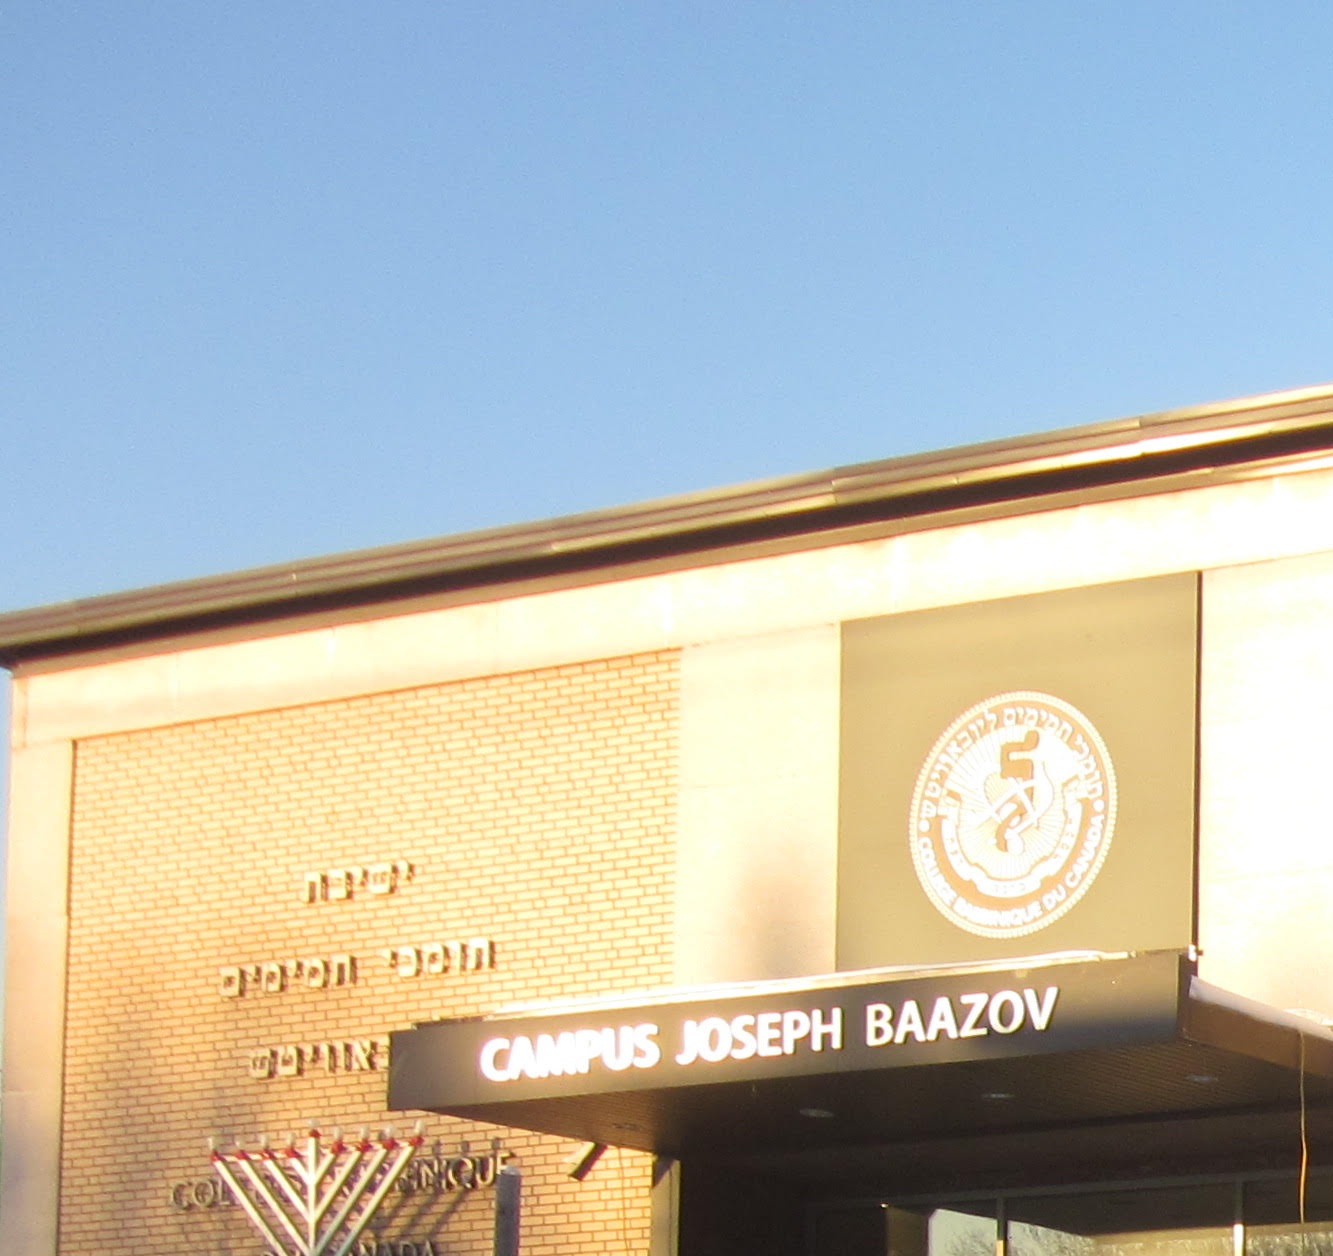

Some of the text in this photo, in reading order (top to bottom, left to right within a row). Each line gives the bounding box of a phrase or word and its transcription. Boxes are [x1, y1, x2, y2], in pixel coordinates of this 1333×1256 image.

[1041, 884, 1066, 911] DU
[217, 936, 496, 999] תומכי תמימים
[479, 985, 1060, 1082] CAMPUS JOSEPH BAAZOV
